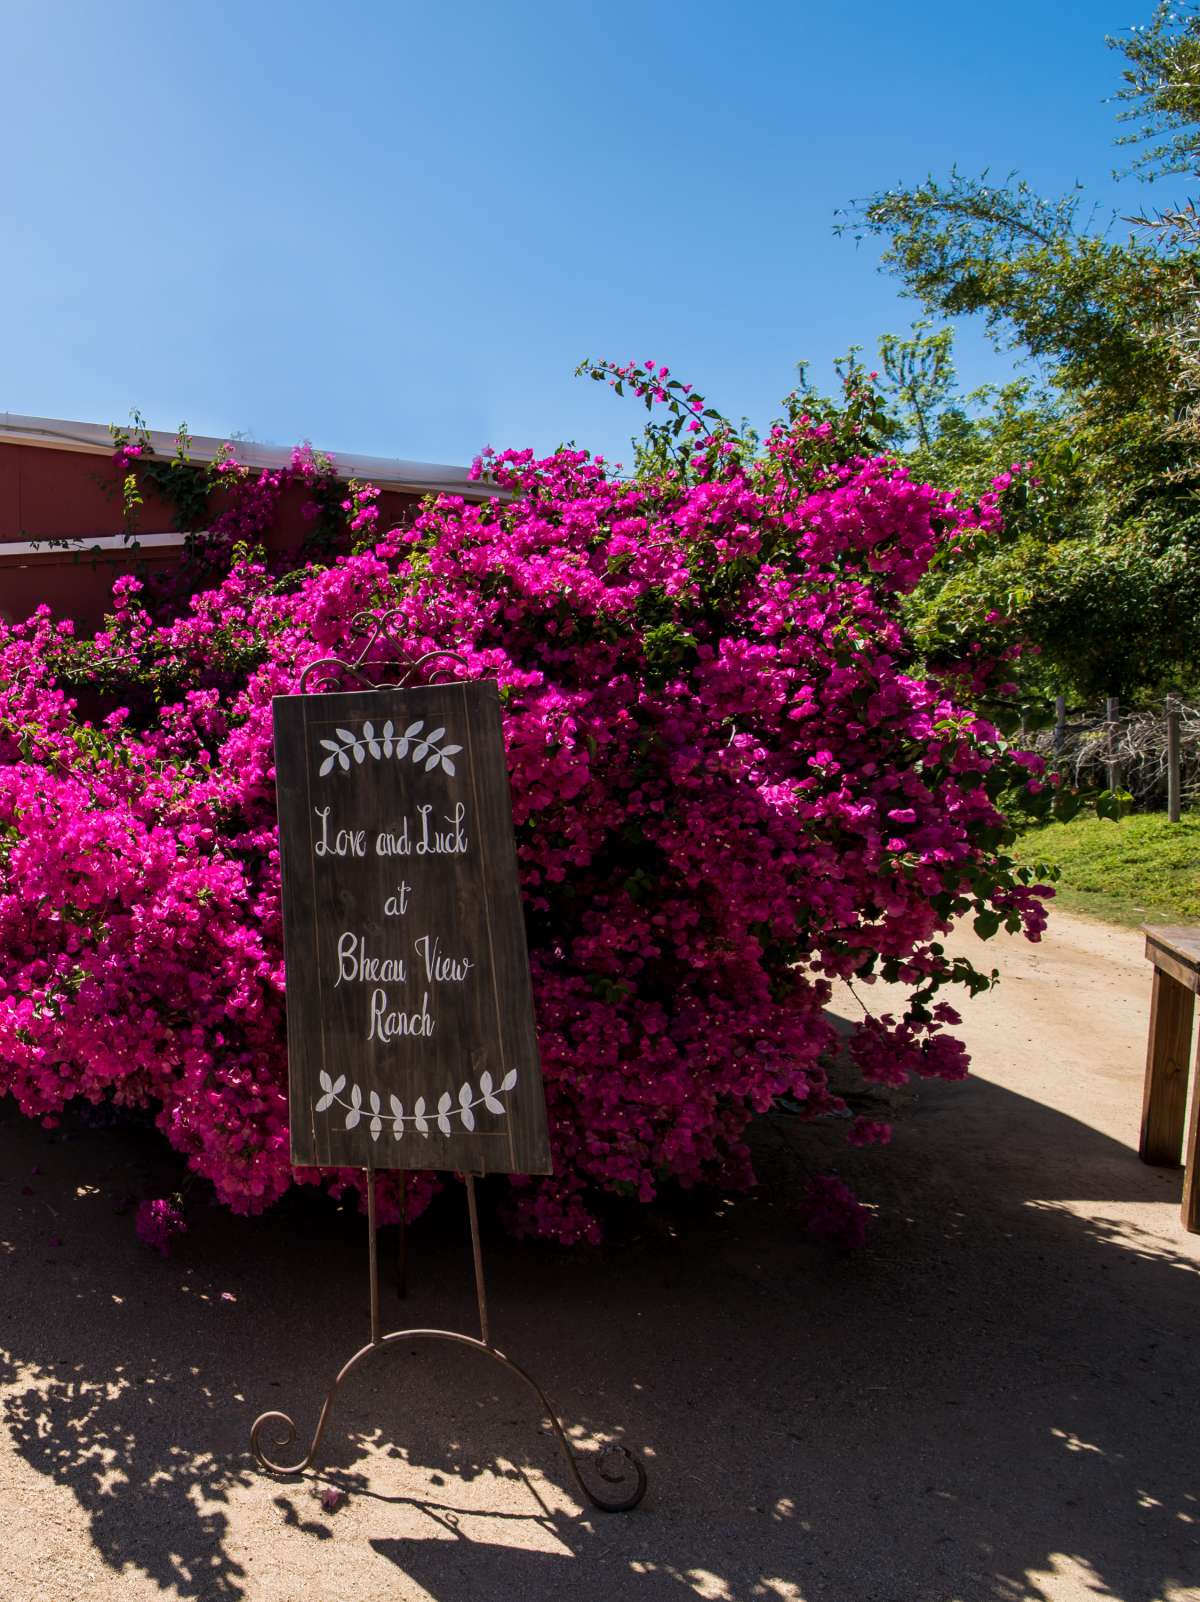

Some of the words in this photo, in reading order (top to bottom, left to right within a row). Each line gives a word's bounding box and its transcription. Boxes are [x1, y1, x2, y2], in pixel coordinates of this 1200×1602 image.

[314, 806, 367, 857] Love
[375, 815, 412, 856] and
[416, 801, 469, 855] Luck
[384, 880, 412, 916] at
[334, 931, 407, 988] Bheau
[414, 935, 475, 983] View
[367, 988, 435, 1043] Ranch
